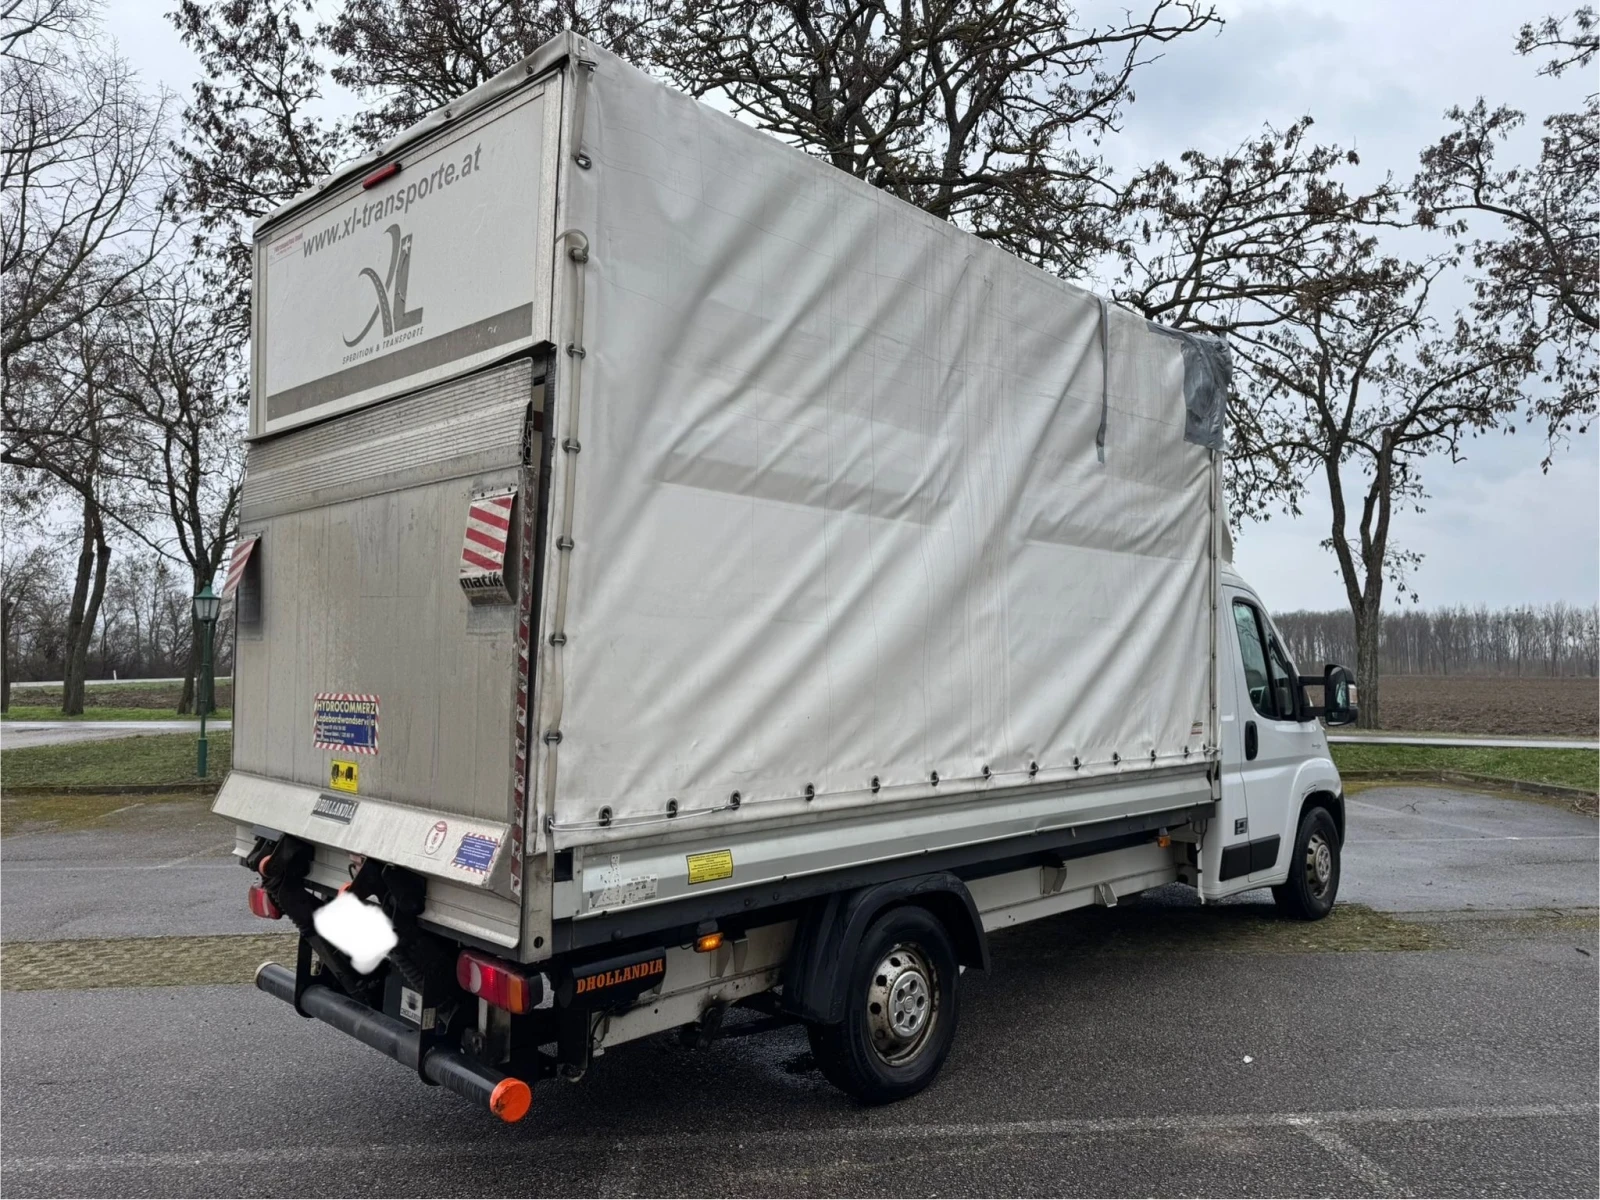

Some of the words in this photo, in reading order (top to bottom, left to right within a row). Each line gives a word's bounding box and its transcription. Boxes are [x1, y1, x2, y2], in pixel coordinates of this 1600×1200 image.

[303, 142, 482, 258] www.xl-transporte.at
[342, 345, 374, 365] SPEDITION
[382, 326, 424, 349] TRANSPORTE
[316, 700, 376, 715] HYDROCOMMERZ
[316, 711, 375, 726] Ladebordwandservie
[313, 798, 358, 818] DHOLLANDIA
[576, 958, 664, 994] DHOLLANDIA
